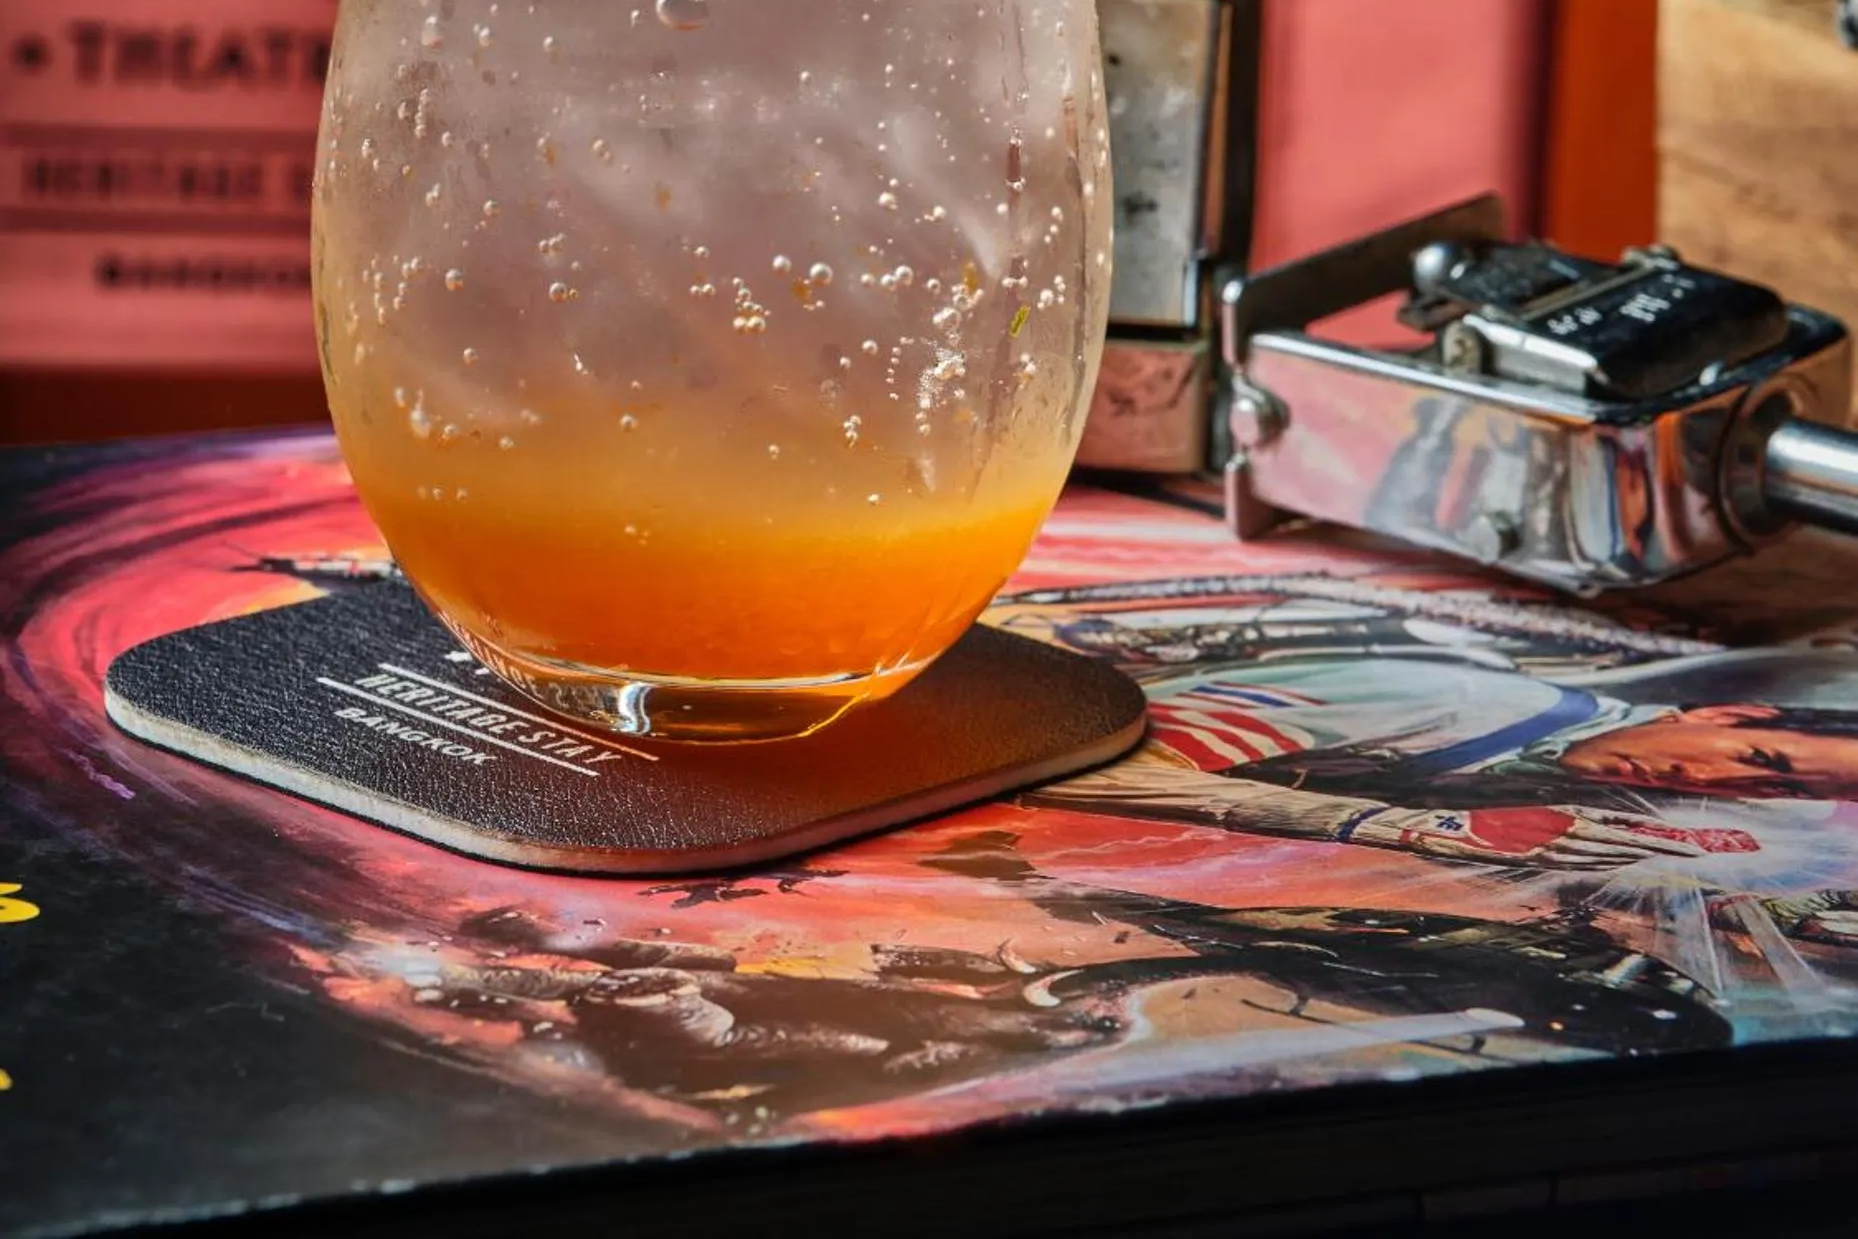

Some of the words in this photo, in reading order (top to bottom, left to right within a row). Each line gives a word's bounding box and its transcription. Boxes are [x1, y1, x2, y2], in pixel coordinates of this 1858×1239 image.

[334, 707, 498, 766] BANGKOK
[353, 673, 532, 734] HERITAGE
[519, 730, 624, 764] STAY
